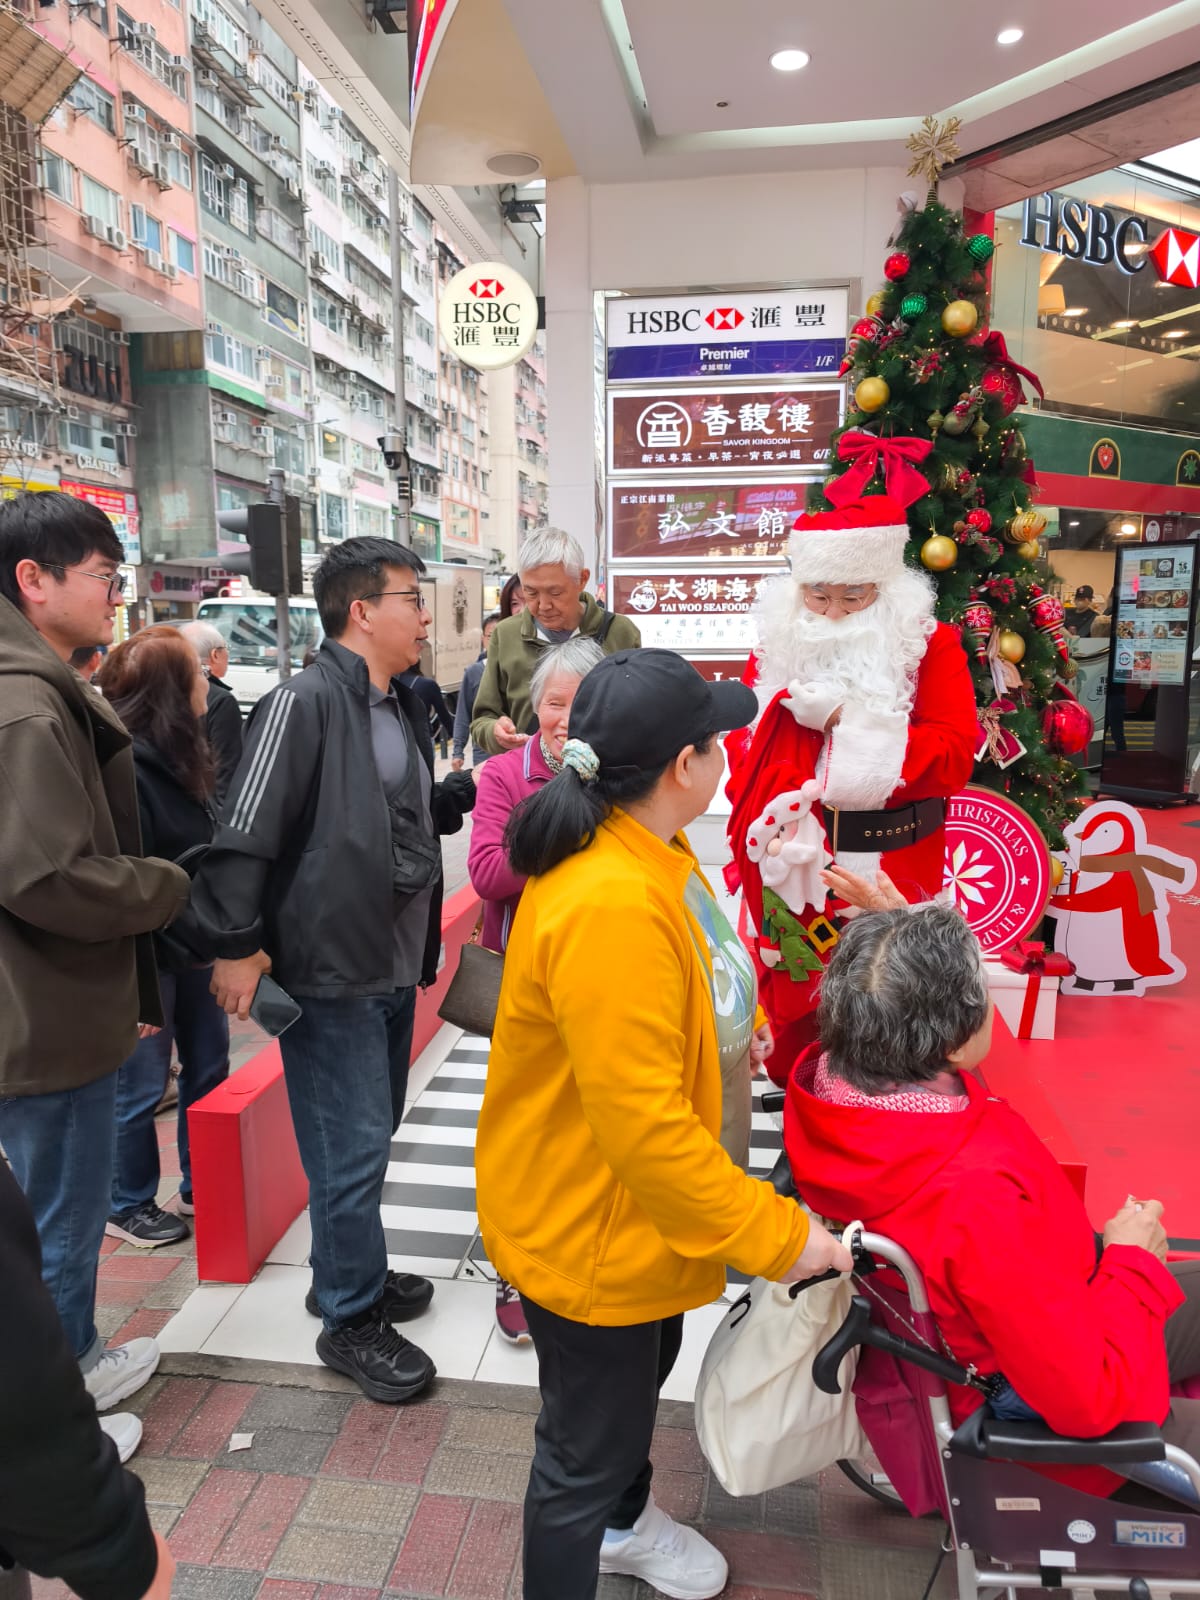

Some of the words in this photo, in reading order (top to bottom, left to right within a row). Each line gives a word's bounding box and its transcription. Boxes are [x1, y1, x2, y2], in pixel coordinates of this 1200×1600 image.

[1018, 191, 1149, 276] HSBC
[453, 302, 521, 324] HSBC
[627, 309, 701, 334] HSBC
[699, 347, 750, 360] Premier
[815, 355, 835, 367] 1/F
[700, 402, 815, 437] 香馥樓
[752, 438, 791, 446] KINGDOM
[813, 448, 832, 460] 6/F
[657, 507, 789, 539] 弘文館
[660, 603, 677, 612] TAI
[679, 603, 702, 612] WOO
[703, 603, 749, 612] SEAFOOD
[949, 803, 1029, 857] HRISTMAS
[1010, 903, 1026, 915] &
[982, 916, 1017, 945] HAP
